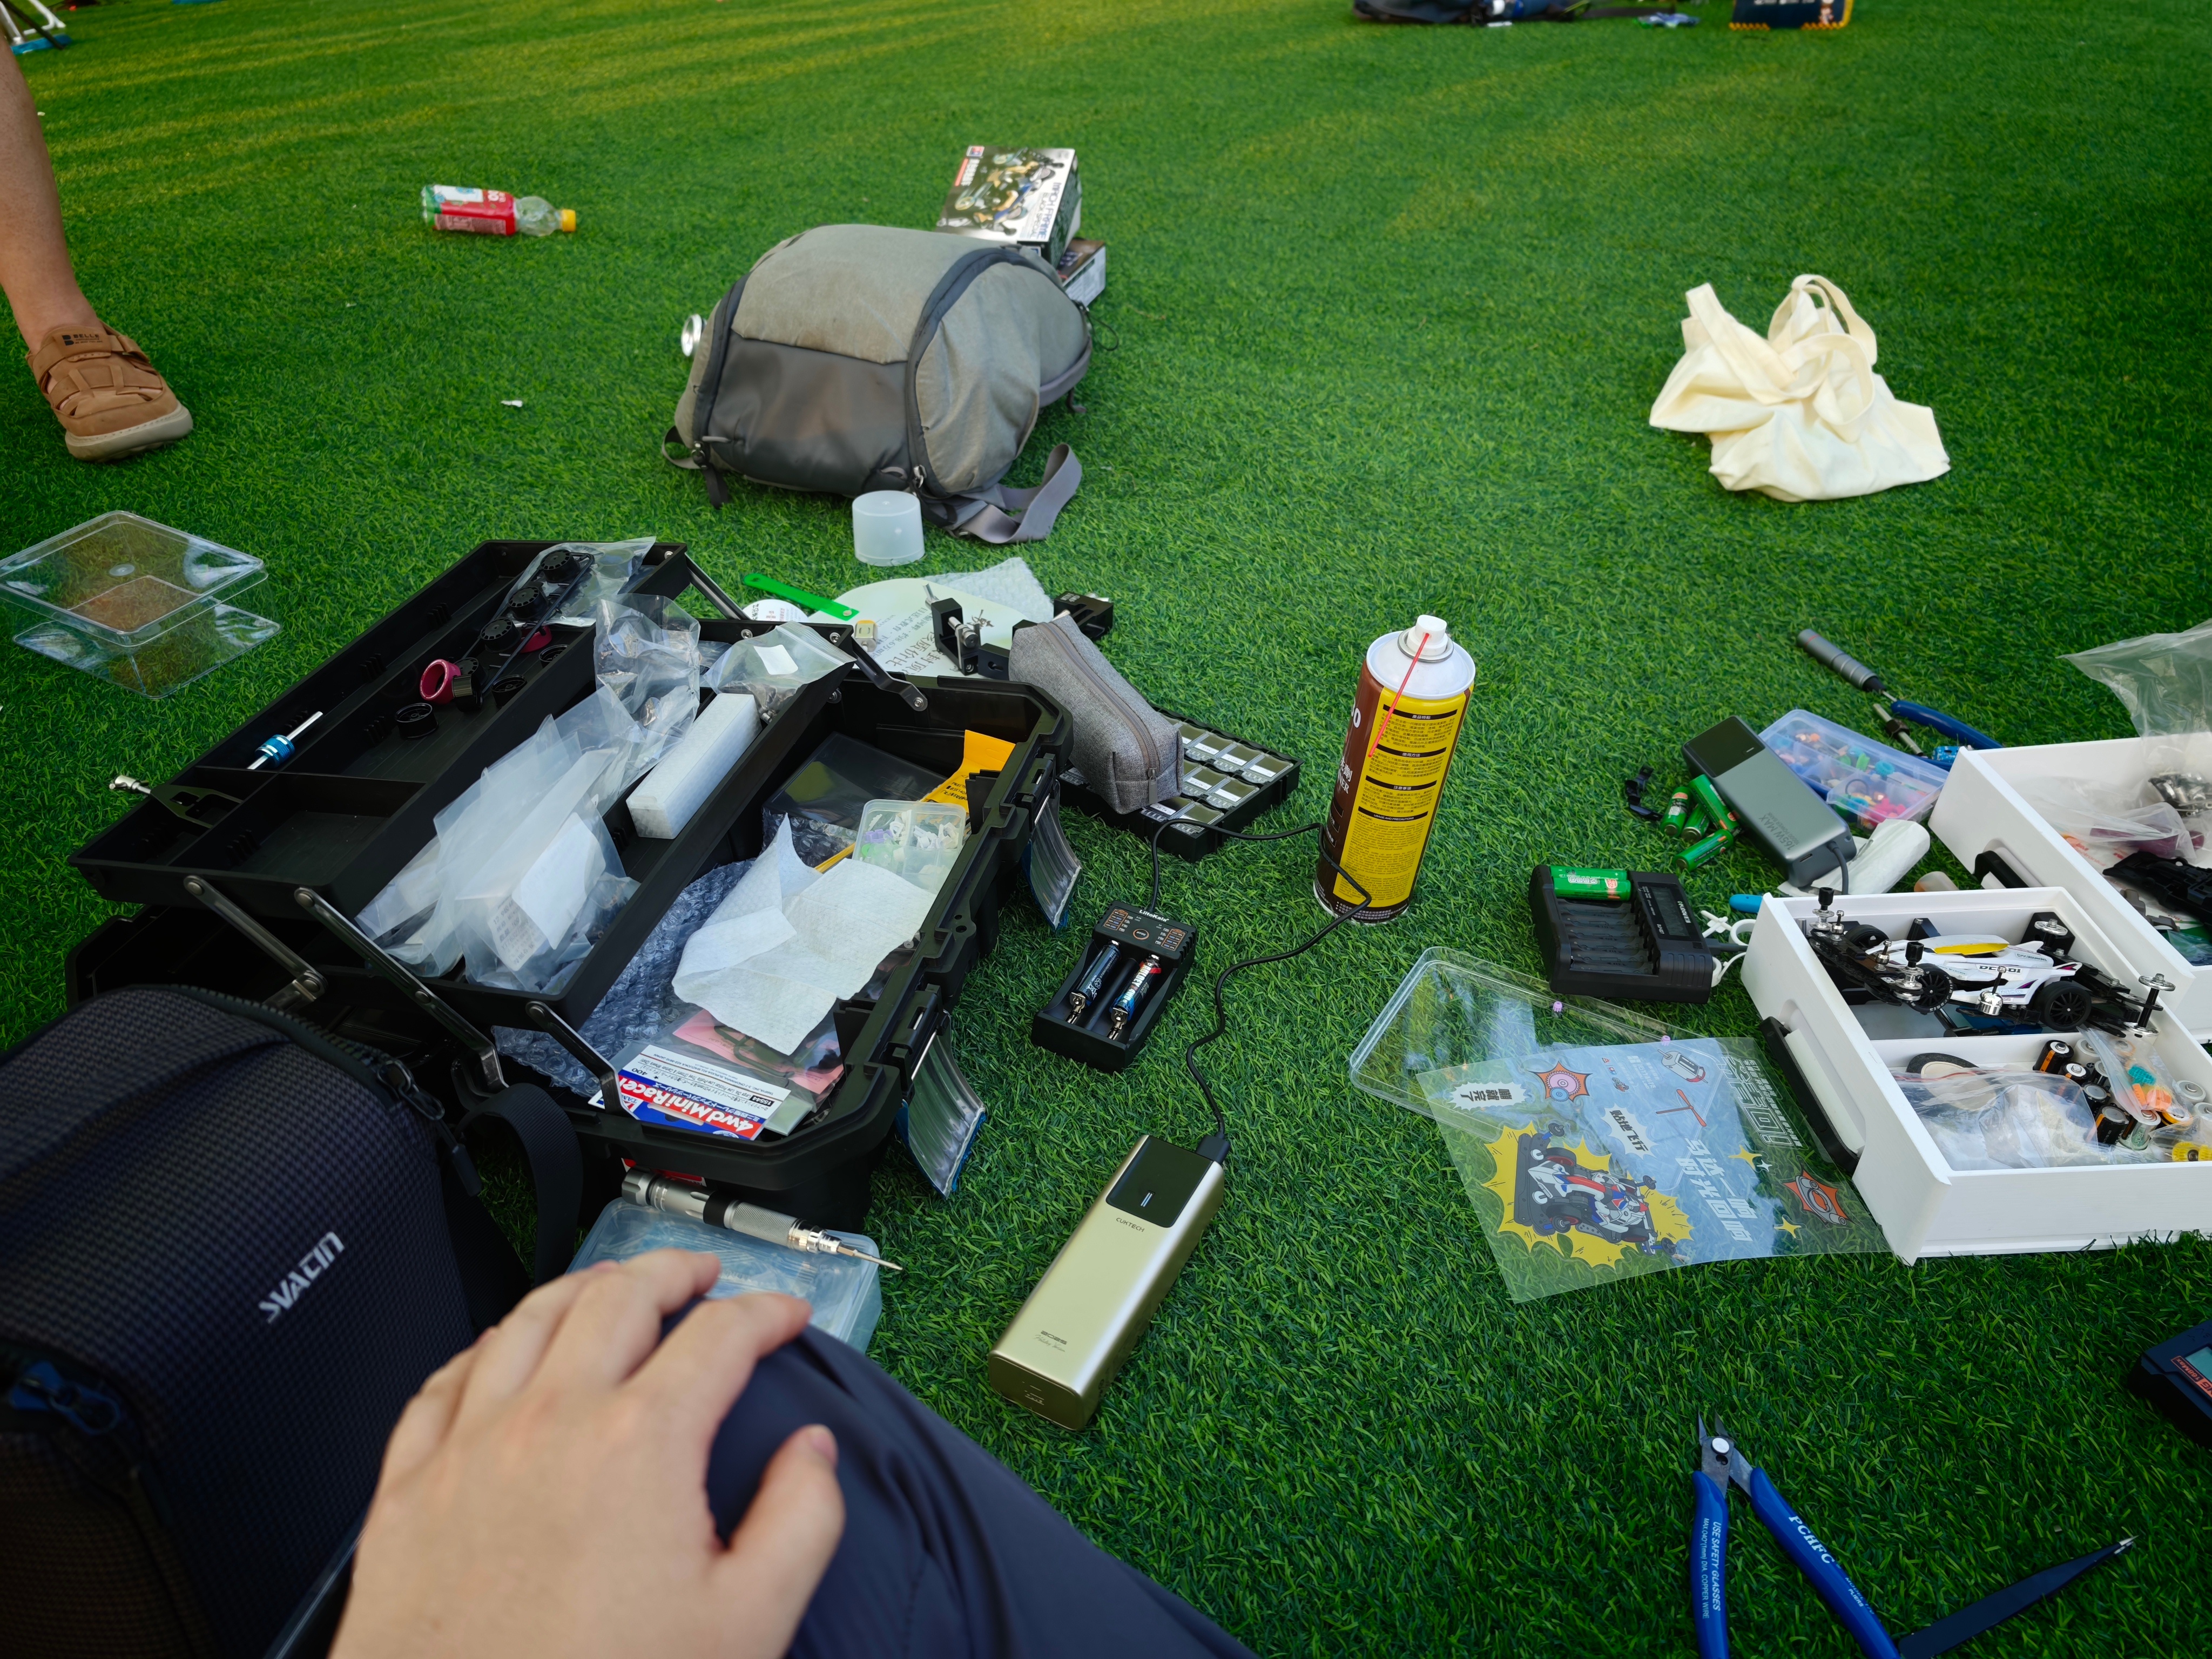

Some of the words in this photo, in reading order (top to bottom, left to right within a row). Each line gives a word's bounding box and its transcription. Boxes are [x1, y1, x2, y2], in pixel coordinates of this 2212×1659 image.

[1758, 813, 1778, 832] MAX
[1772, 830, 1795, 851] 165W
[631, 1067, 648, 1076] 400
[649, 1061, 662, 1069] Wheels
[714, 1082, 727, 1090] Friction
[751, 1095, 772, 1105] 15544
[1609, 1110, 1649, 1151] 贴地飞行
[1686, 1139, 1758, 1219] 马达一响
[1675, 1158, 1753, 1242] 时光回响
[1116, 1217, 1145, 1232] CUKTECH
[1711, 1521, 1720, 1537] USE
[1711, 1537, 1719, 1569] SAFETY
[1712, 1570, 1721, 1611] GLASSES
